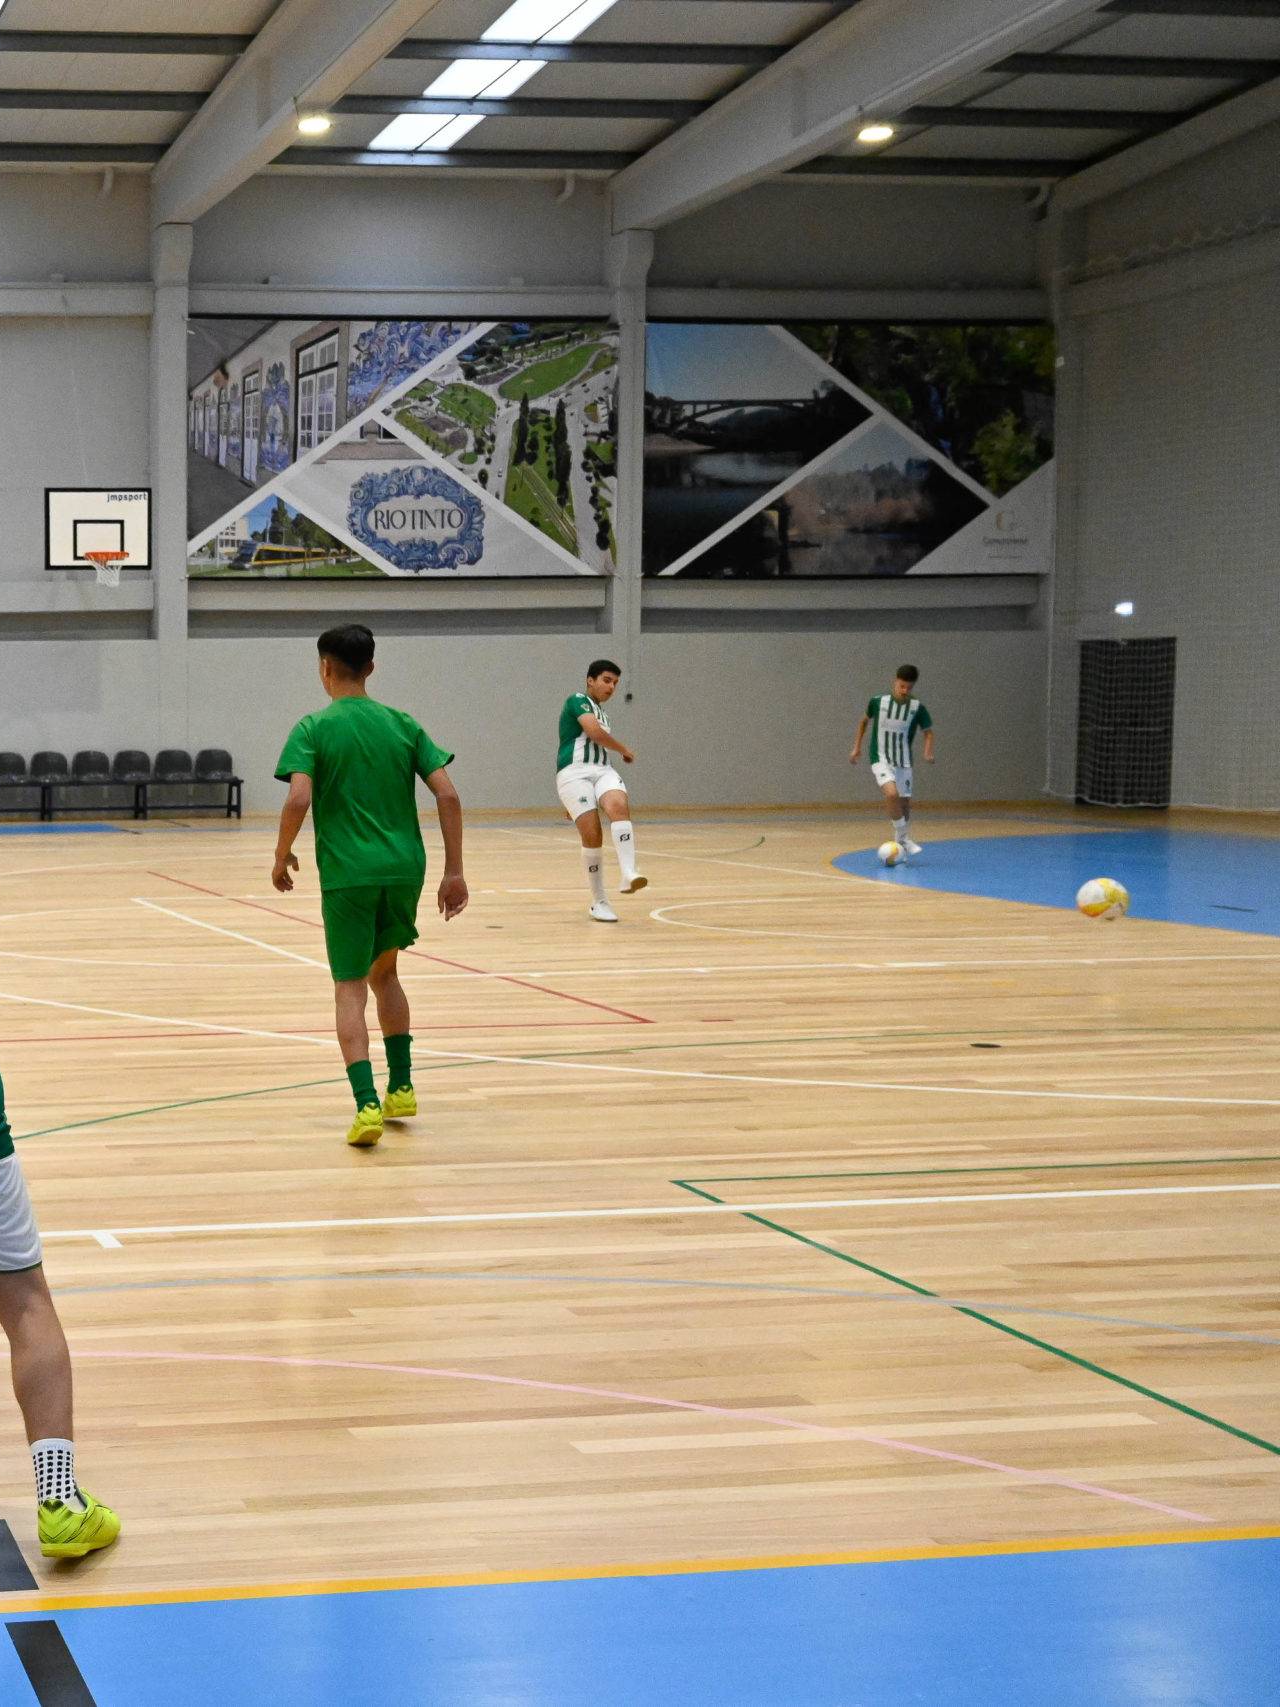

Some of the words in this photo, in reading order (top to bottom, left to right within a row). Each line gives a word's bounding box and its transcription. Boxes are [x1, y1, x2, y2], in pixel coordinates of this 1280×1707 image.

[107, 493, 147, 503] jmpsport
[373, 509, 406, 530] RIO
[407, 508, 464, 530] TINTO
